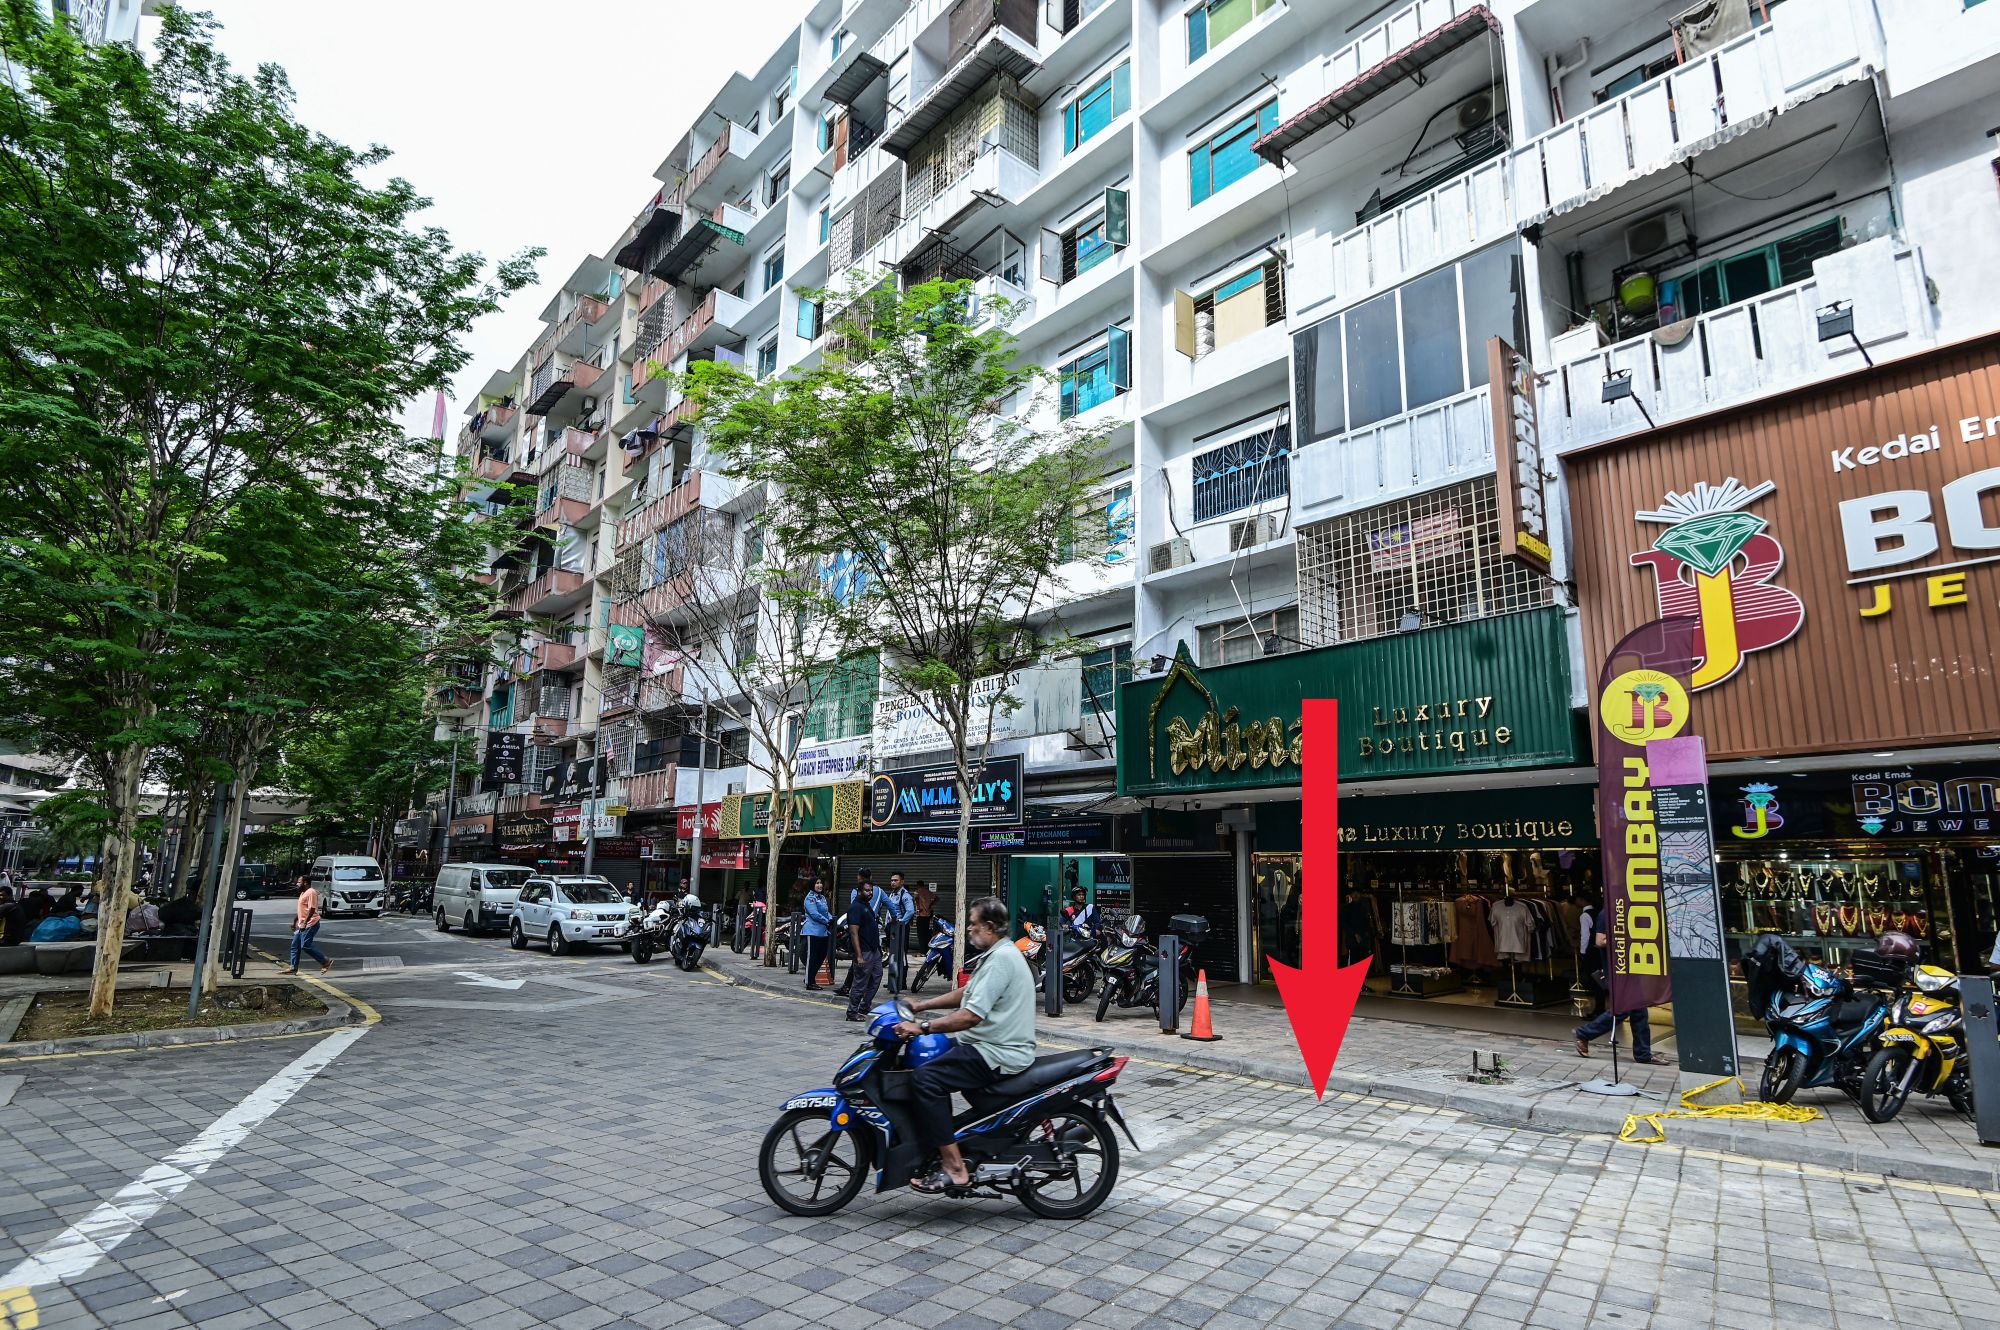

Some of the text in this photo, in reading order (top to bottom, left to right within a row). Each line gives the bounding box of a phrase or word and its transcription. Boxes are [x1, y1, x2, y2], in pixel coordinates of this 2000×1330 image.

[1832, 425, 1942, 474] Kedai
[1373, 696, 1492, 726] Luxury
[1358, 726, 1512, 756] Boutique
[817, 757, 844, 776] ENTERPRISE
[1851, 770, 1912, 781] Kedai Emas
[1036, 830, 1070, 839] EXCHANGE
[1364, 823, 1446, 843] Luxury
[1457, 818, 1574, 842] Boutique
[1891, 818, 1991, 833] JEWE
[918, 835, 945, 843] CURRENCY
[1622, 757, 1661, 976] BOMBAY
[1613, 898, 1627, 975] Kedai Emas
[1911, 1001, 1927, 1012] P
